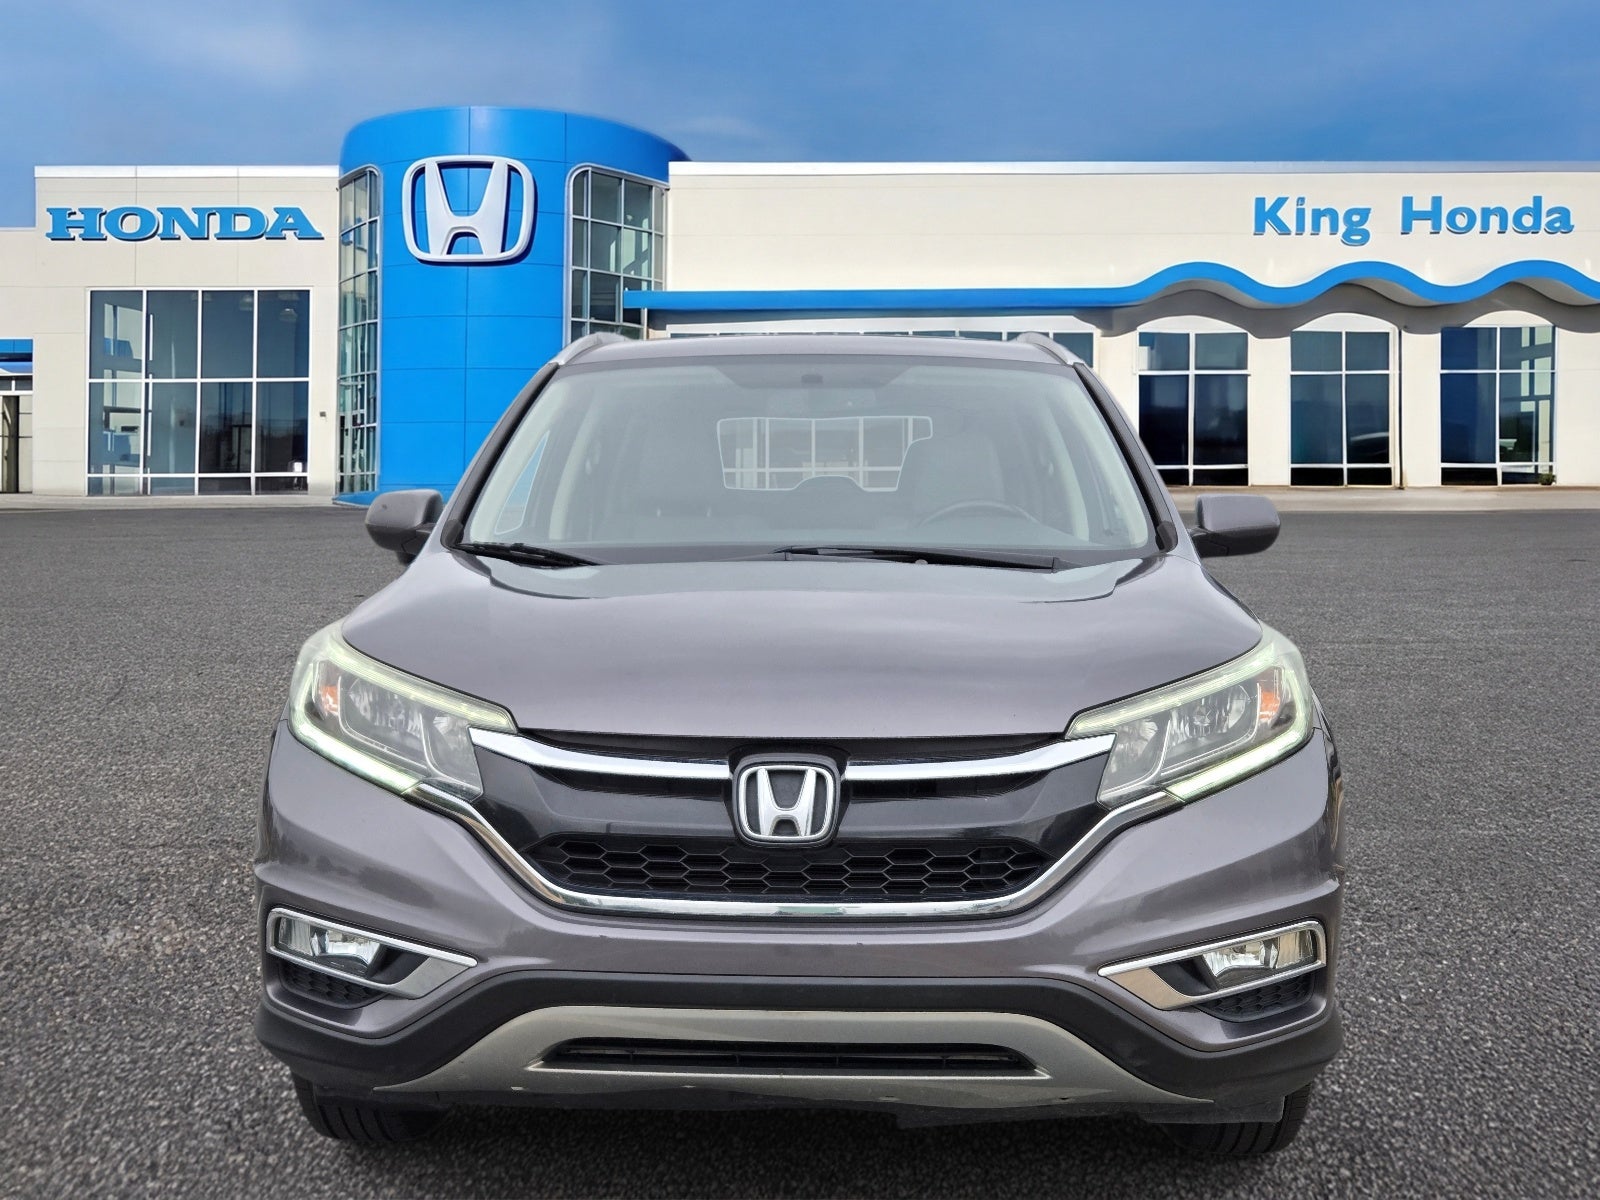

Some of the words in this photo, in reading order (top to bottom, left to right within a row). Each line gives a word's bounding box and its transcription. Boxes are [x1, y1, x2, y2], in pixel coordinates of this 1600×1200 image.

[45, 206, 324, 241] HONDA
[1253, 196, 1372, 246] King
[1400, 195, 1575, 235] Honda
